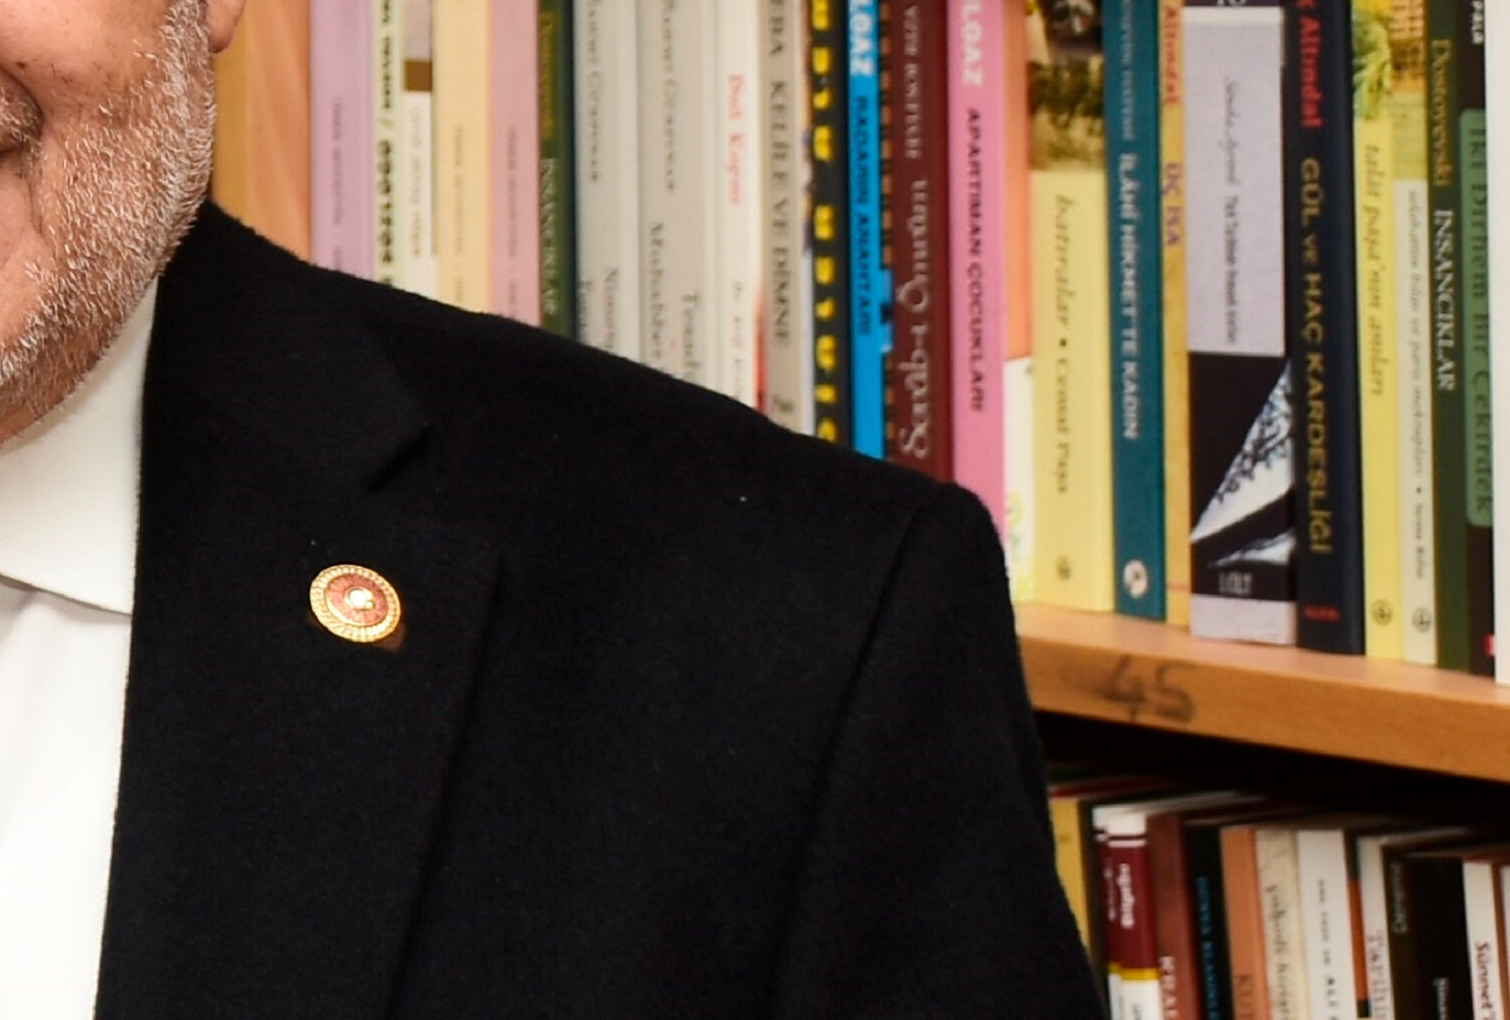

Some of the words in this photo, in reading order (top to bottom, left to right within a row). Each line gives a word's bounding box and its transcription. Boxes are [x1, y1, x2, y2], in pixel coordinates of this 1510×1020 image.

[1470, 0, 1484, 45] PALA
[1300, 15, 1324, 129] Altındal
[1301, 156, 1324, 226] GÜL
[966, 262, 986, 413] ÇOCUKLARI
[1301, 272, 1326, 345] HAÇ
[1433, 209, 1457, 391] İNSANCIKLAR
[1122, 360, 1144, 440] KADIN
[1305, 351, 1336, 555] KARDEŞLİĞİ
